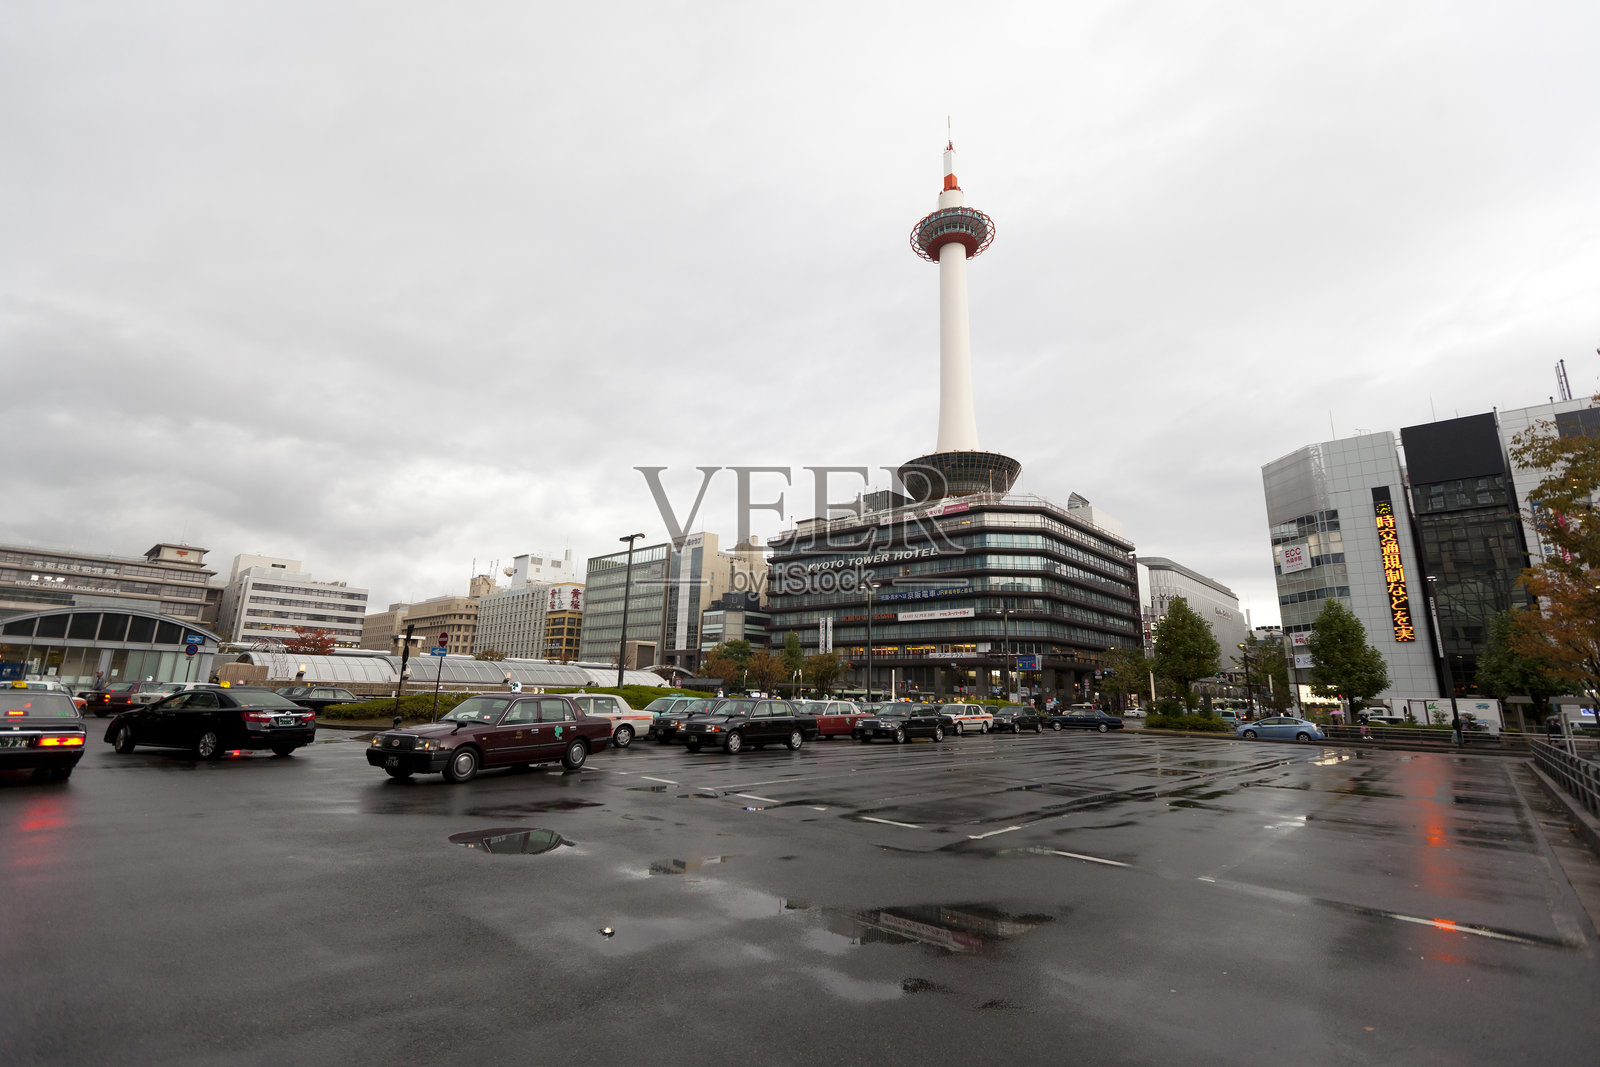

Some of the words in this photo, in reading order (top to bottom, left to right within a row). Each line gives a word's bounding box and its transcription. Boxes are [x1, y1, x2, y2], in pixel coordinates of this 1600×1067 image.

[1285, 547, 1301, 558] ECC
[808, 561, 845, 573] KYOTO
[848, 554, 890, 568] TOWER
[894, 547, 939, 561] HOTEL
[15, 580, 40, 588] KYOTO
[42, 581, 74, 591] CENTRAL
[76, 585, 96, 593] POST
[97, 586, 121, 595] OFFICE
[907, 589, 937, 599] 京阪電車
